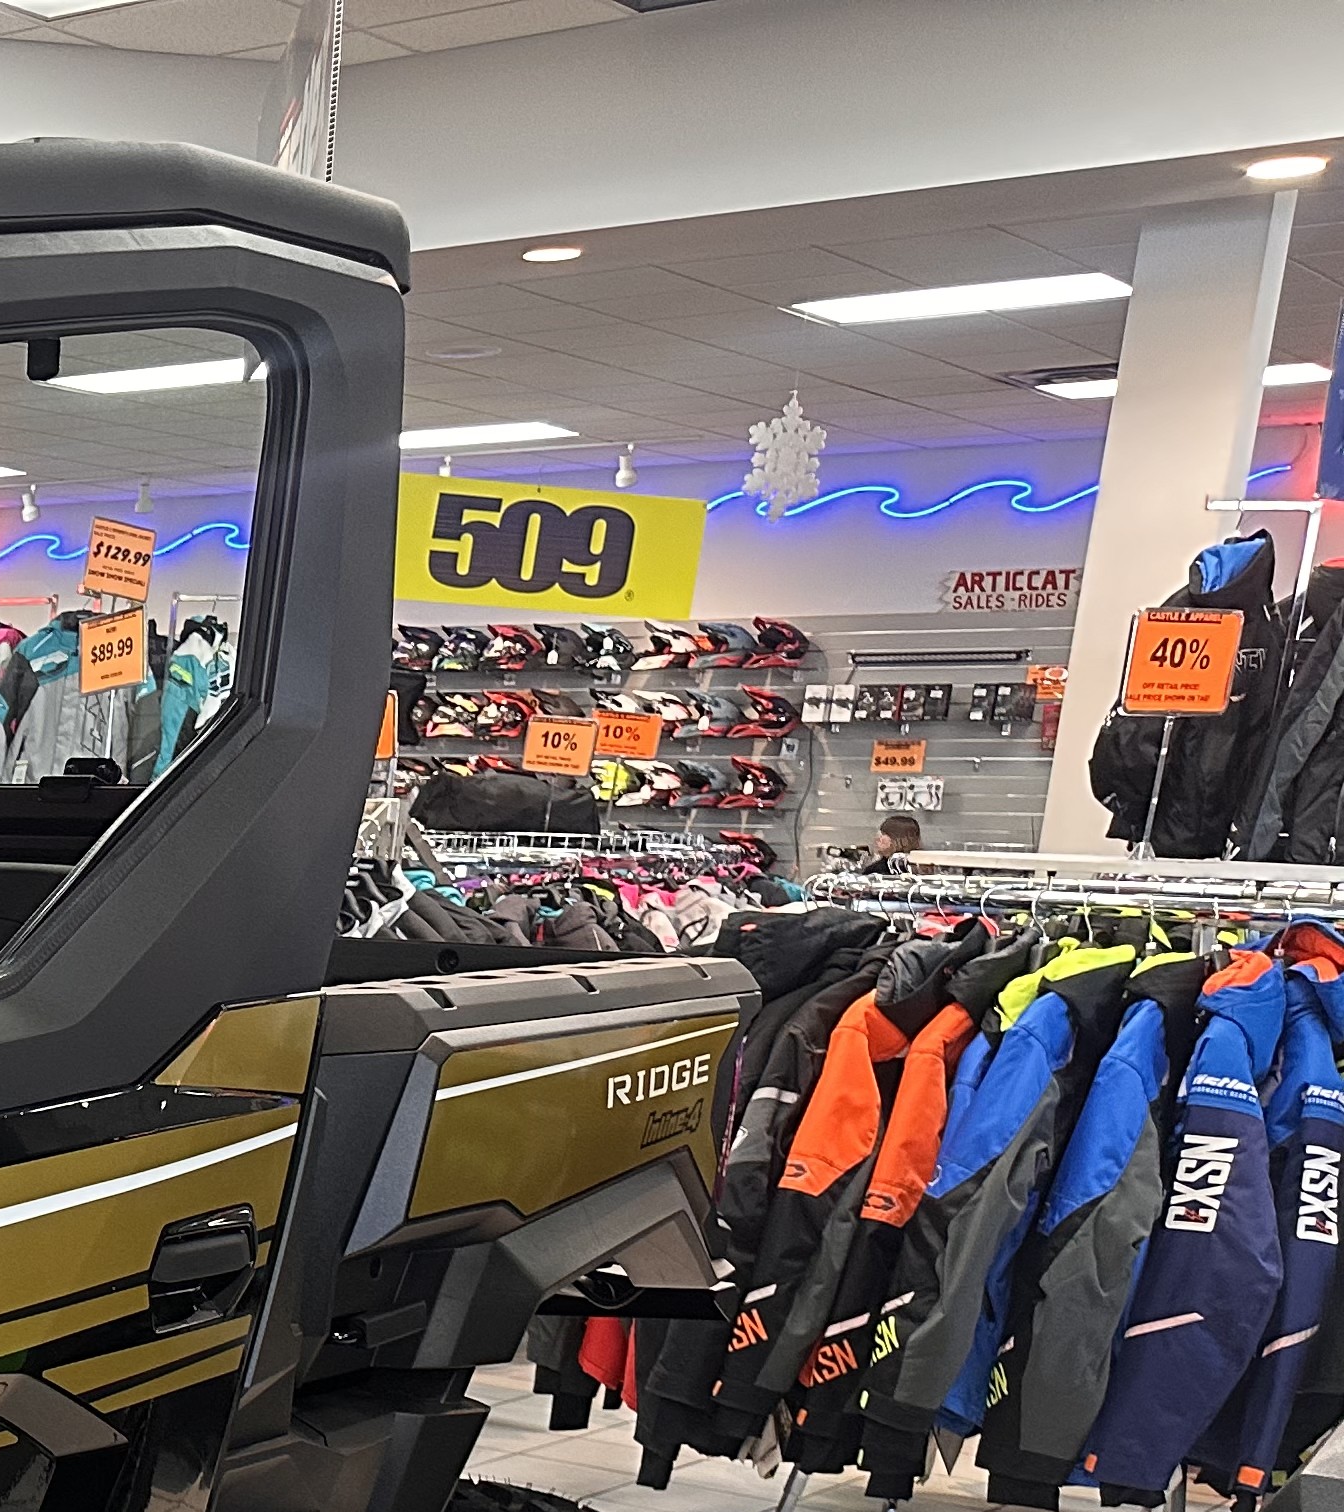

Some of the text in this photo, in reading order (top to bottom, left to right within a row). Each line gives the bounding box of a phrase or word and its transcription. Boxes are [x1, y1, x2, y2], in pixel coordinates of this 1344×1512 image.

[92, 541, 151, 567] $129.99
[428, 492, 636, 599] 509
[952, 594, 1005, 610] SALES
[1017, 592, 1068, 609] RIDES
[90, 636, 134, 666] $89.99
[1149, 637, 1211, 670] 40%
[540, 730, 578, 752] 10%
[602, 724, 641, 742] 10%
[607, 1053, 711, 1109] RIDGE
[1165, 1134, 1239, 1233] CXSN
[1296, 1144, 1341, 1245] CXSN
[727, 1307, 769, 1352] SN
